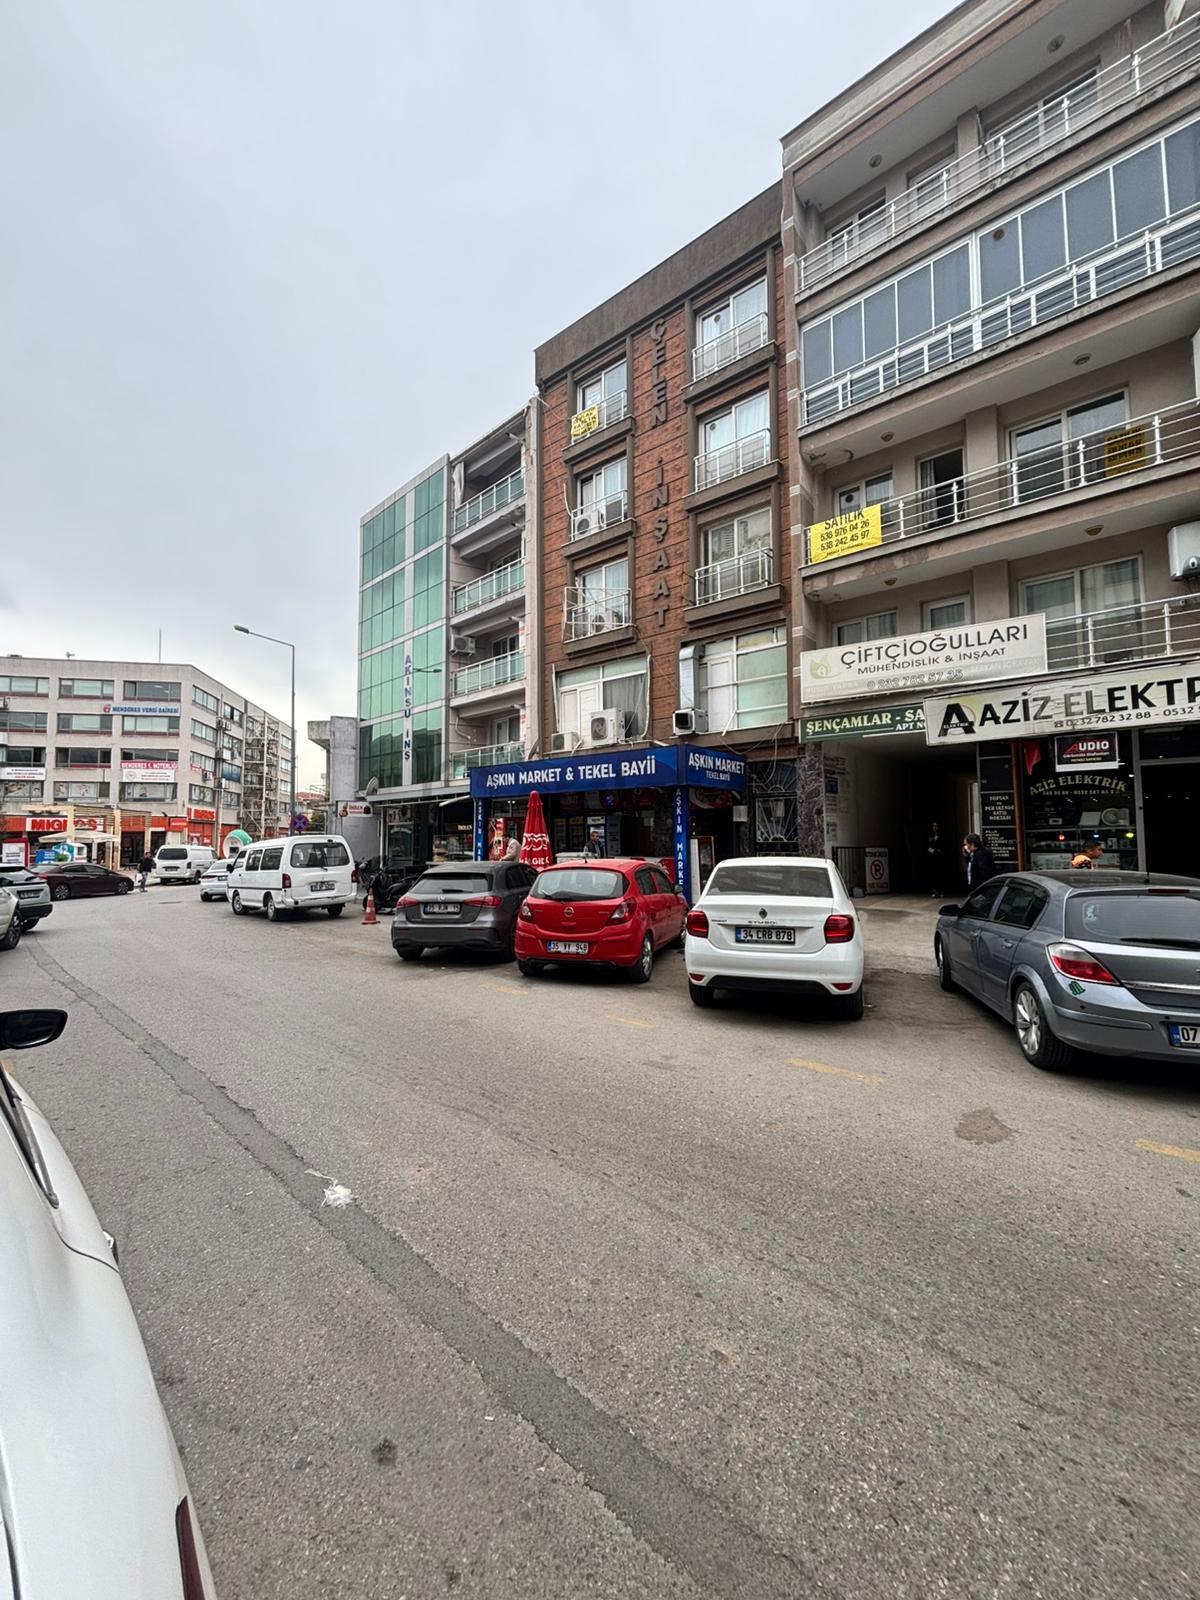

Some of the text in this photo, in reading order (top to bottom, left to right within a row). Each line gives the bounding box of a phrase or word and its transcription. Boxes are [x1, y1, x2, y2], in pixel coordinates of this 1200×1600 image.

[820, 519, 870, 542] 538 976 04 26
[825, 510, 864, 530] SATILIK
[652, 457, 670, 627] İNŞAAT
[820, 541, 834, 551] 538
[834, 537, 848, 547] 242
[860, 530, 870, 539] 97
[840, 623, 1028, 670] ÇİFTÇİOĞULLARI
[857, 647, 1007, 675] MÜHENDİSLİK & İNŞAAT
[978, 690, 1054, 728] AZİZ
[1119, 712, 1133, 722] 32
[1135, 710, 1152, 720] 88
[1162, 706, 1194, 717] 0532
[805, 712, 892, 736] ŞENÇAMLAR
[895, 722, 916, 731] APT
[1065, 740, 1110, 754] AUDIO
[486, 755, 656, 790] AŞKIN MARKET & TEKEL BAYİİ
[689, 752, 745, 775] AŞKIN MARKET
[1029, 774, 1127, 796] AZİZ ELEKTRİK
[742, 929, 793, 941] 34 CRB 878
[1181, 1027, 1198, 1042] 07
